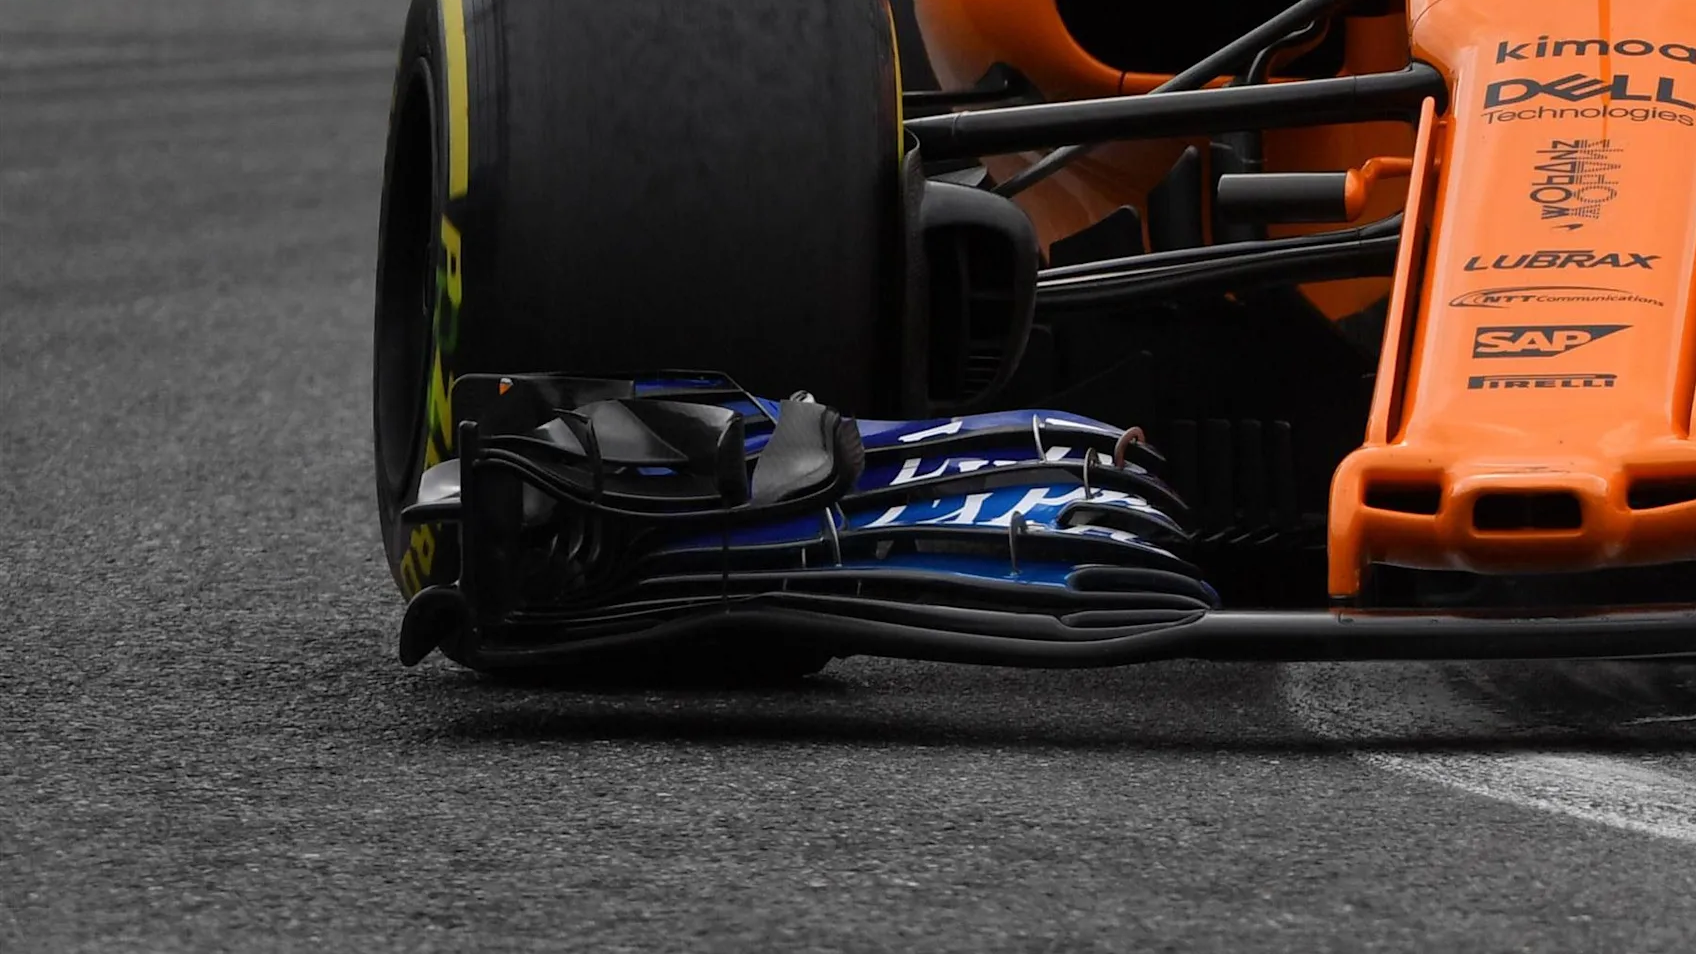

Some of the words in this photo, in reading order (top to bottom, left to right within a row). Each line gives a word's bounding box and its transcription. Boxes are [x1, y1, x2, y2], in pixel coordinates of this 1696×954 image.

[1484, 73, 1696, 110] DELL
[1481, 105, 1694, 127] Technologies
[1463, 250, 1662, 272] LUBRAX
[1482, 294, 1536, 304] NTT
[1536, 294, 1665, 307] Communications
[1474, 329, 1592, 354] SAP
[1467, 374, 1618, 390] PIRELLI
